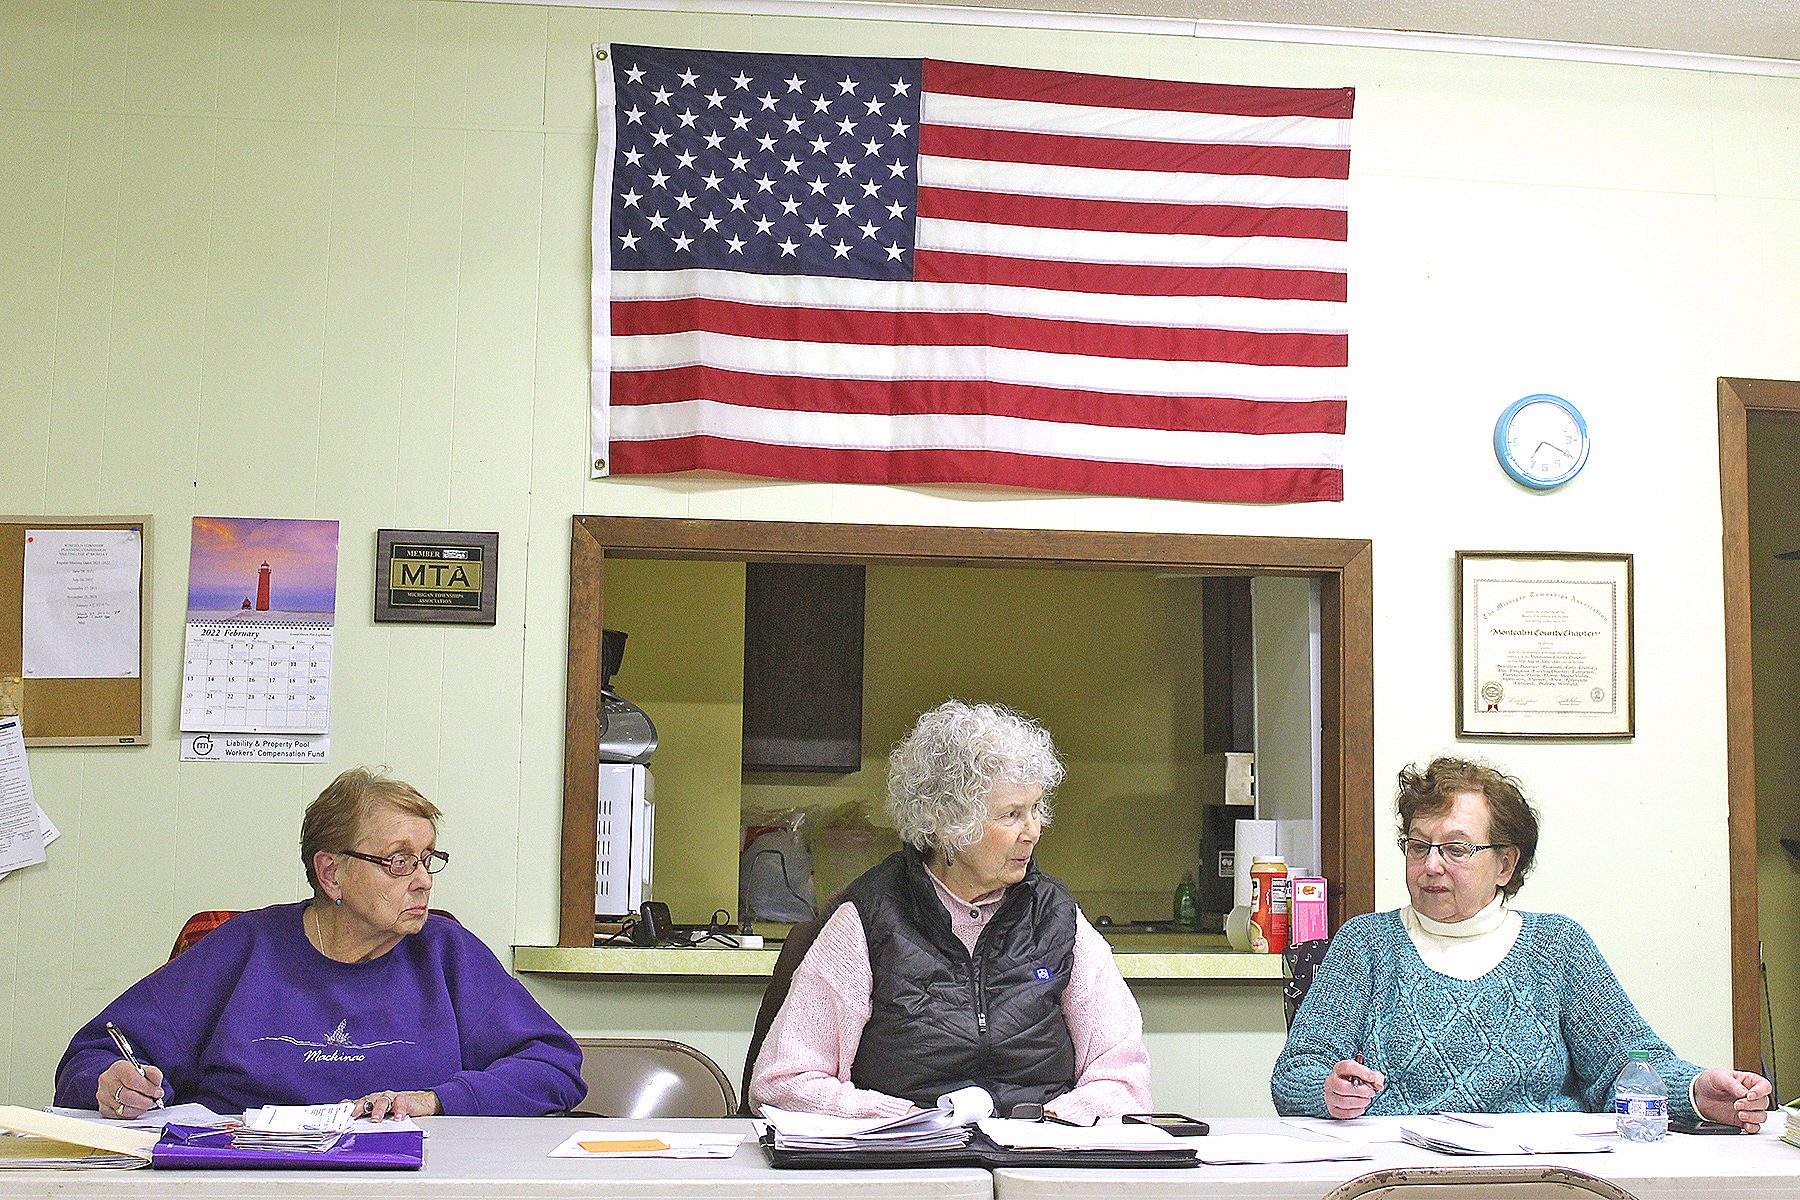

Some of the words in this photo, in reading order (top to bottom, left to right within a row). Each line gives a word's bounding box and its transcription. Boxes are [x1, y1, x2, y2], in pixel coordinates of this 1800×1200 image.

[402, 564, 470, 587] MTA
[224, 629, 259, 640] February
[226, 740, 253, 748] Liability
[263, 740, 293, 749] Property
[258, 750, 306, 758] Compensation
